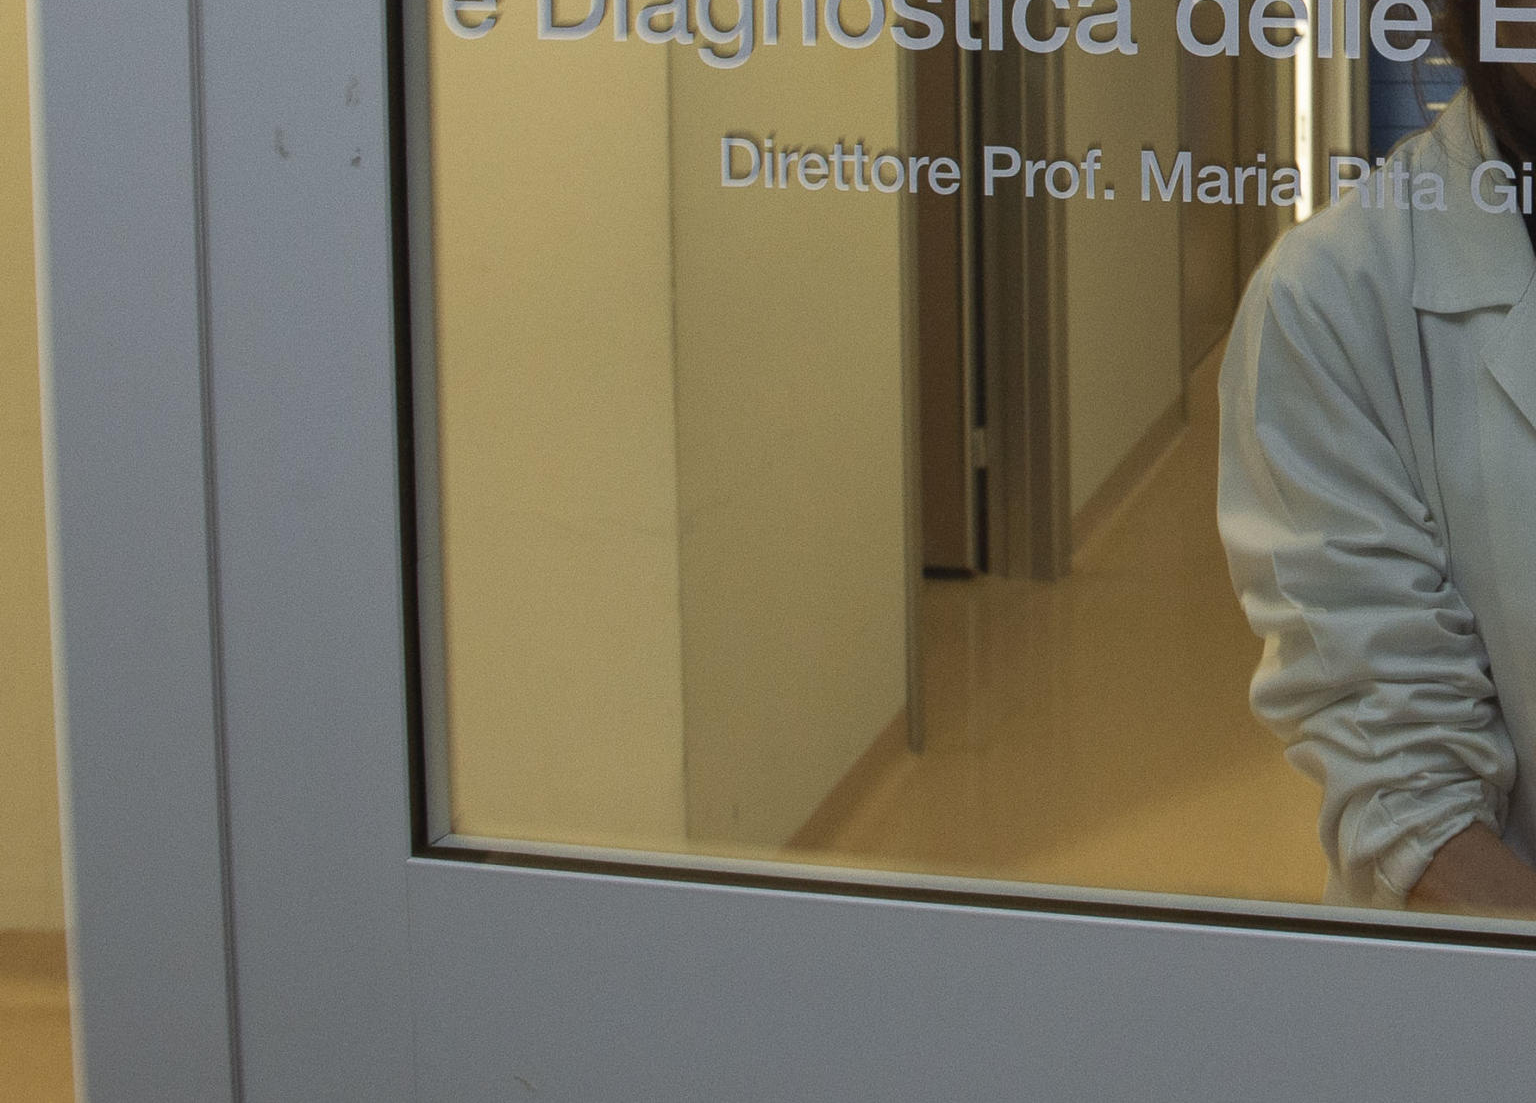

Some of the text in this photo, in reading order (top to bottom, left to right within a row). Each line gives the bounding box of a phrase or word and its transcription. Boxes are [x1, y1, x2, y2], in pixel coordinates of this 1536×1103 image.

[719, 136, 961, 197] Direttore
[984, 144, 1115, 201] Prof.
[1140, 149, 1303, 208] Maria
[1329, 155, 1448, 211] Rita
